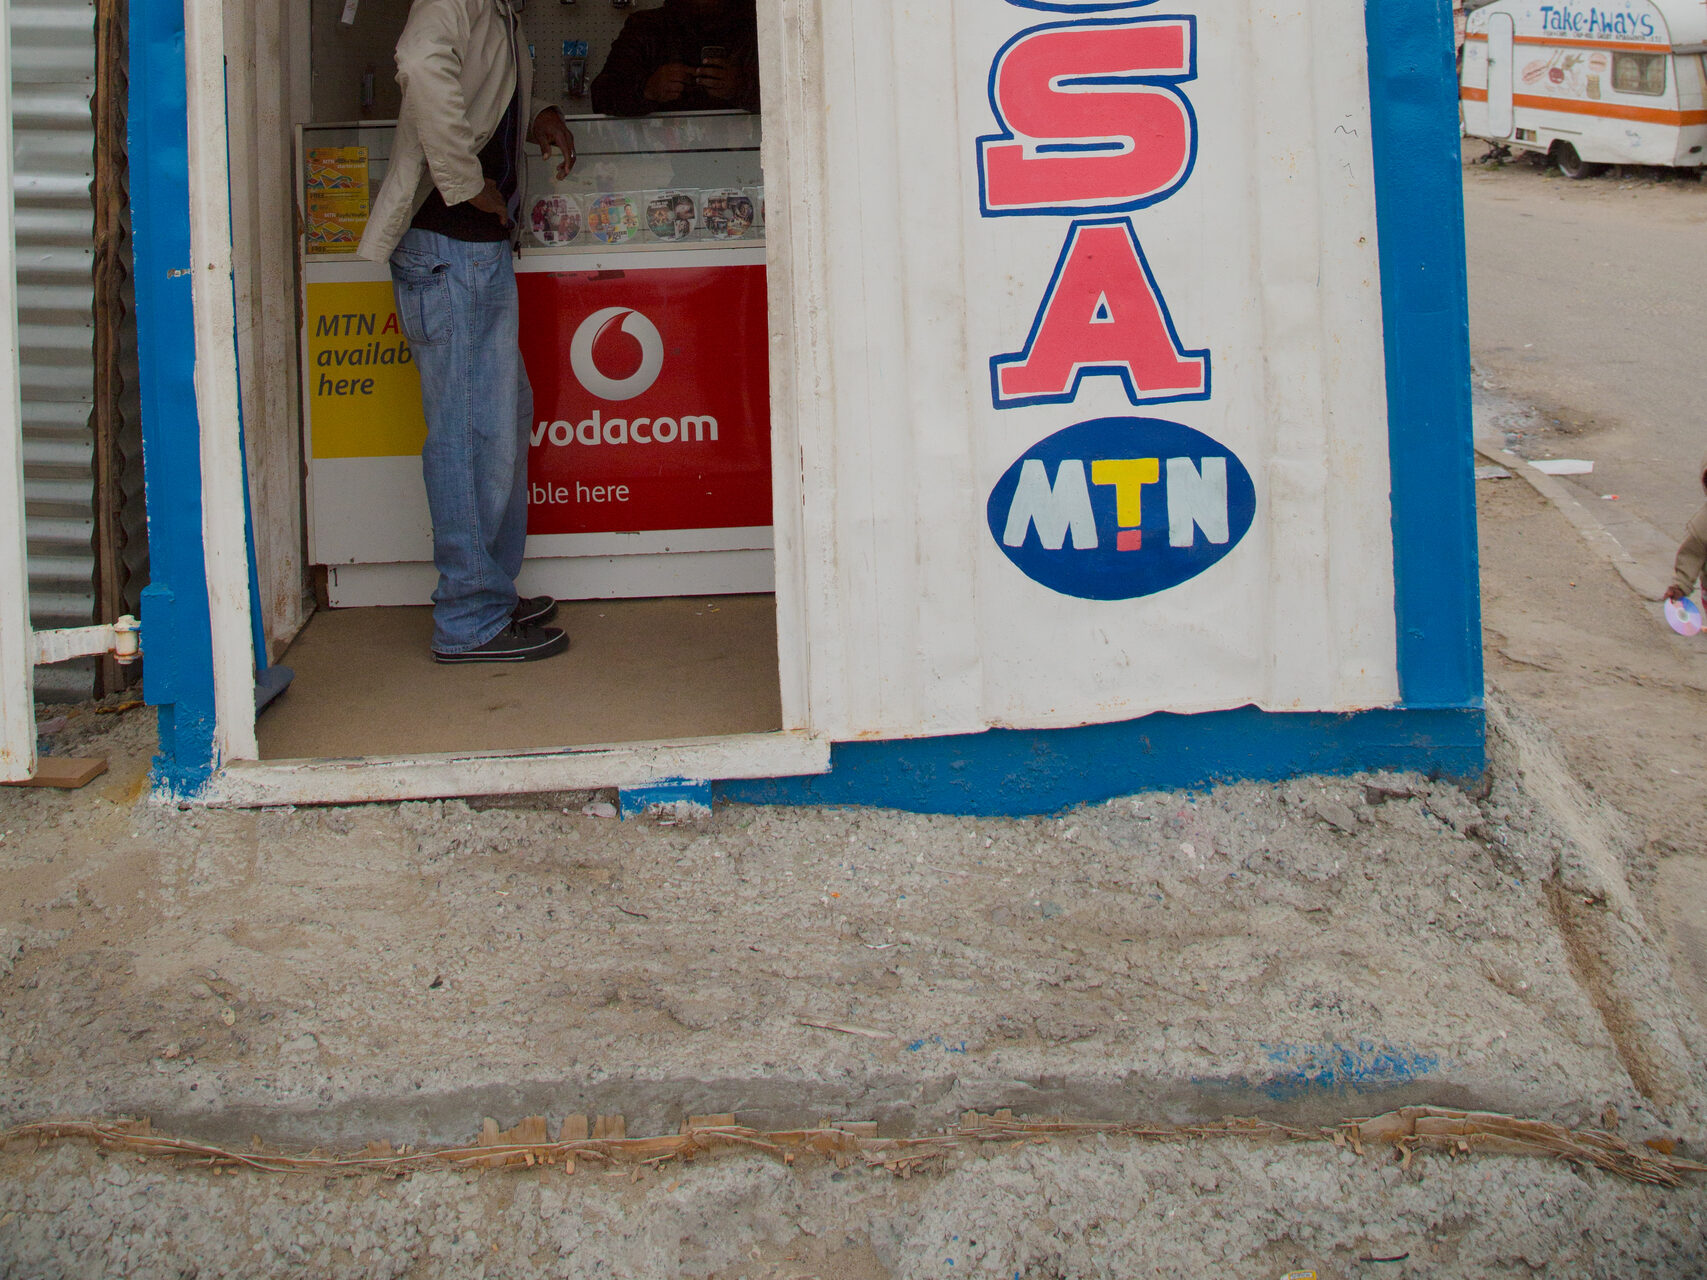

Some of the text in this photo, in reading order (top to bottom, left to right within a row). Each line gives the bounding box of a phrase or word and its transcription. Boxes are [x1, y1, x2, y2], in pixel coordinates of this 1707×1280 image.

[316, 313, 376, 337] MTN
[318, 373, 374, 396] here
[576, 481, 630, 503] here
[1002, 457, 1230, 551] MTN
